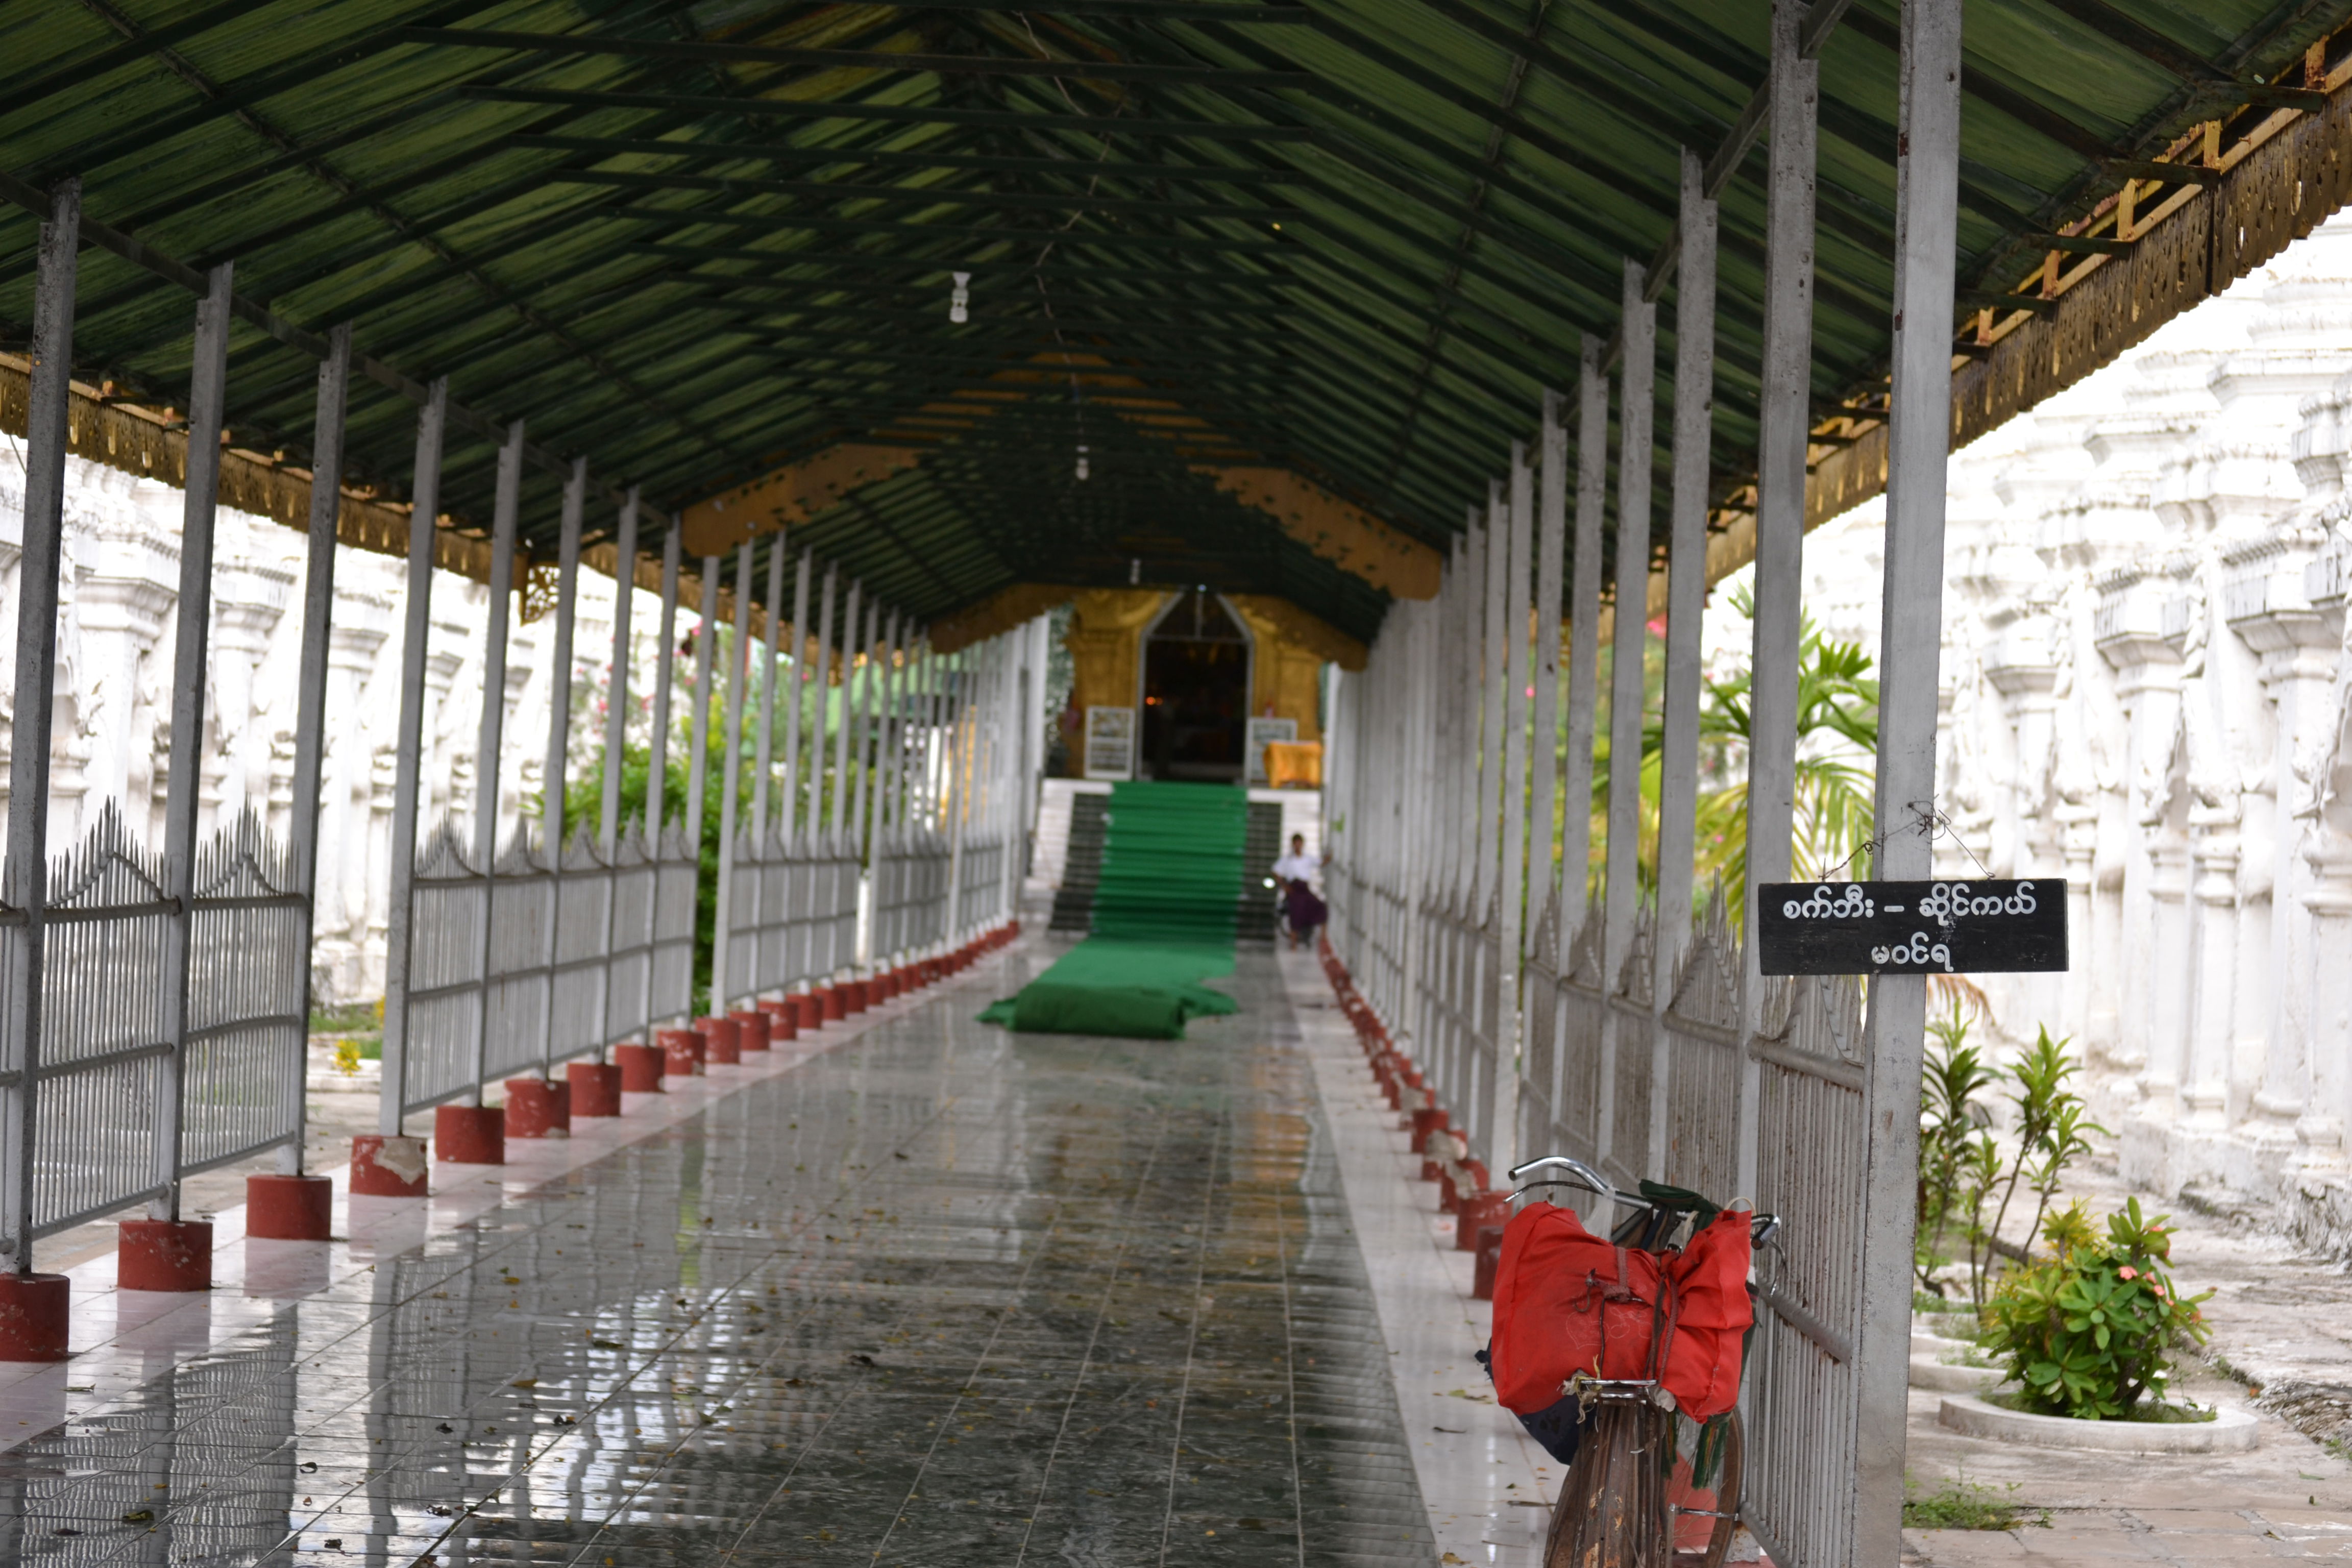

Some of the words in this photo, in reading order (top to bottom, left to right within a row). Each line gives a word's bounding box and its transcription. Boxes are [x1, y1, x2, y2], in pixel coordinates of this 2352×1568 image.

[1783, 884, 1874, 919] စက်ဘီး
[1919, 881, 2036, 926] ဆိုင်ကယ်
[1871, 932, 1954, 972] မဝင်ရ
